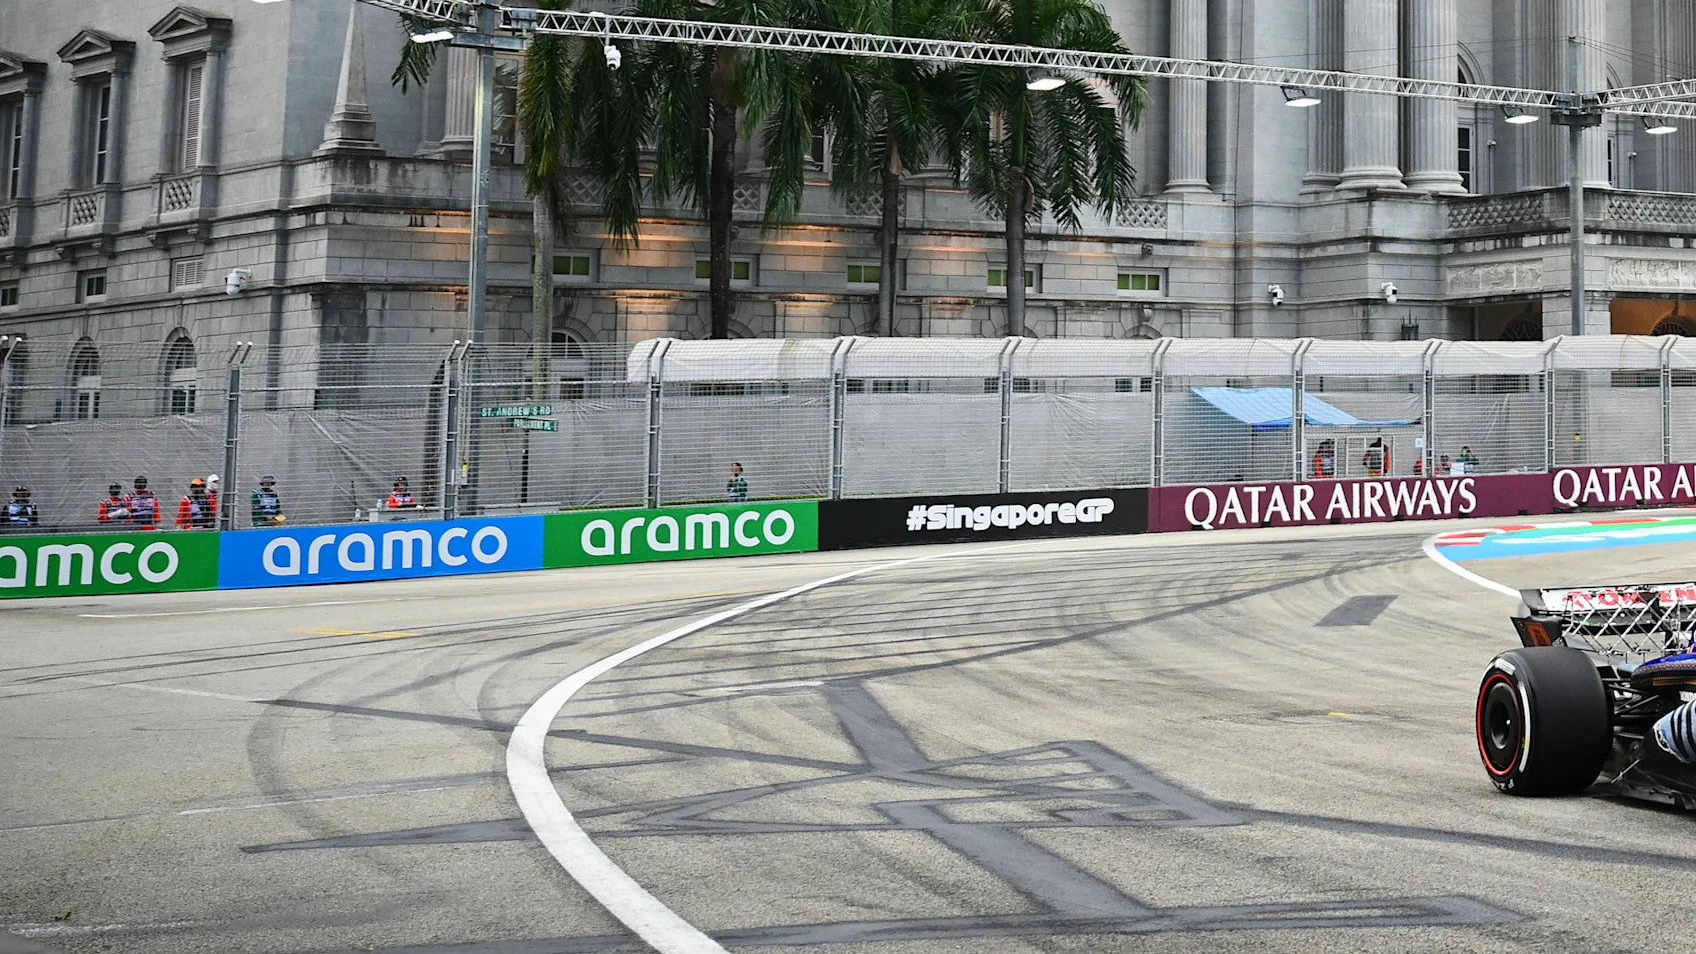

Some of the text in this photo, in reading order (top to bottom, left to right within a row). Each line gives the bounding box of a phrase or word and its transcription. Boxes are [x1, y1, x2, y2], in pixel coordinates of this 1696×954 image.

[481, 405, 551, 417] ST. ANDREW'S RD
[1184, 478, 1477, 530] QATAR AIRWAYS
[1553, 464, 1664, 508] QATAR
[581, 509, 795, 556] aramco
[906, 498, 1115, 531] #SingaporeGP
[263, 526, 508, 576] aramco
